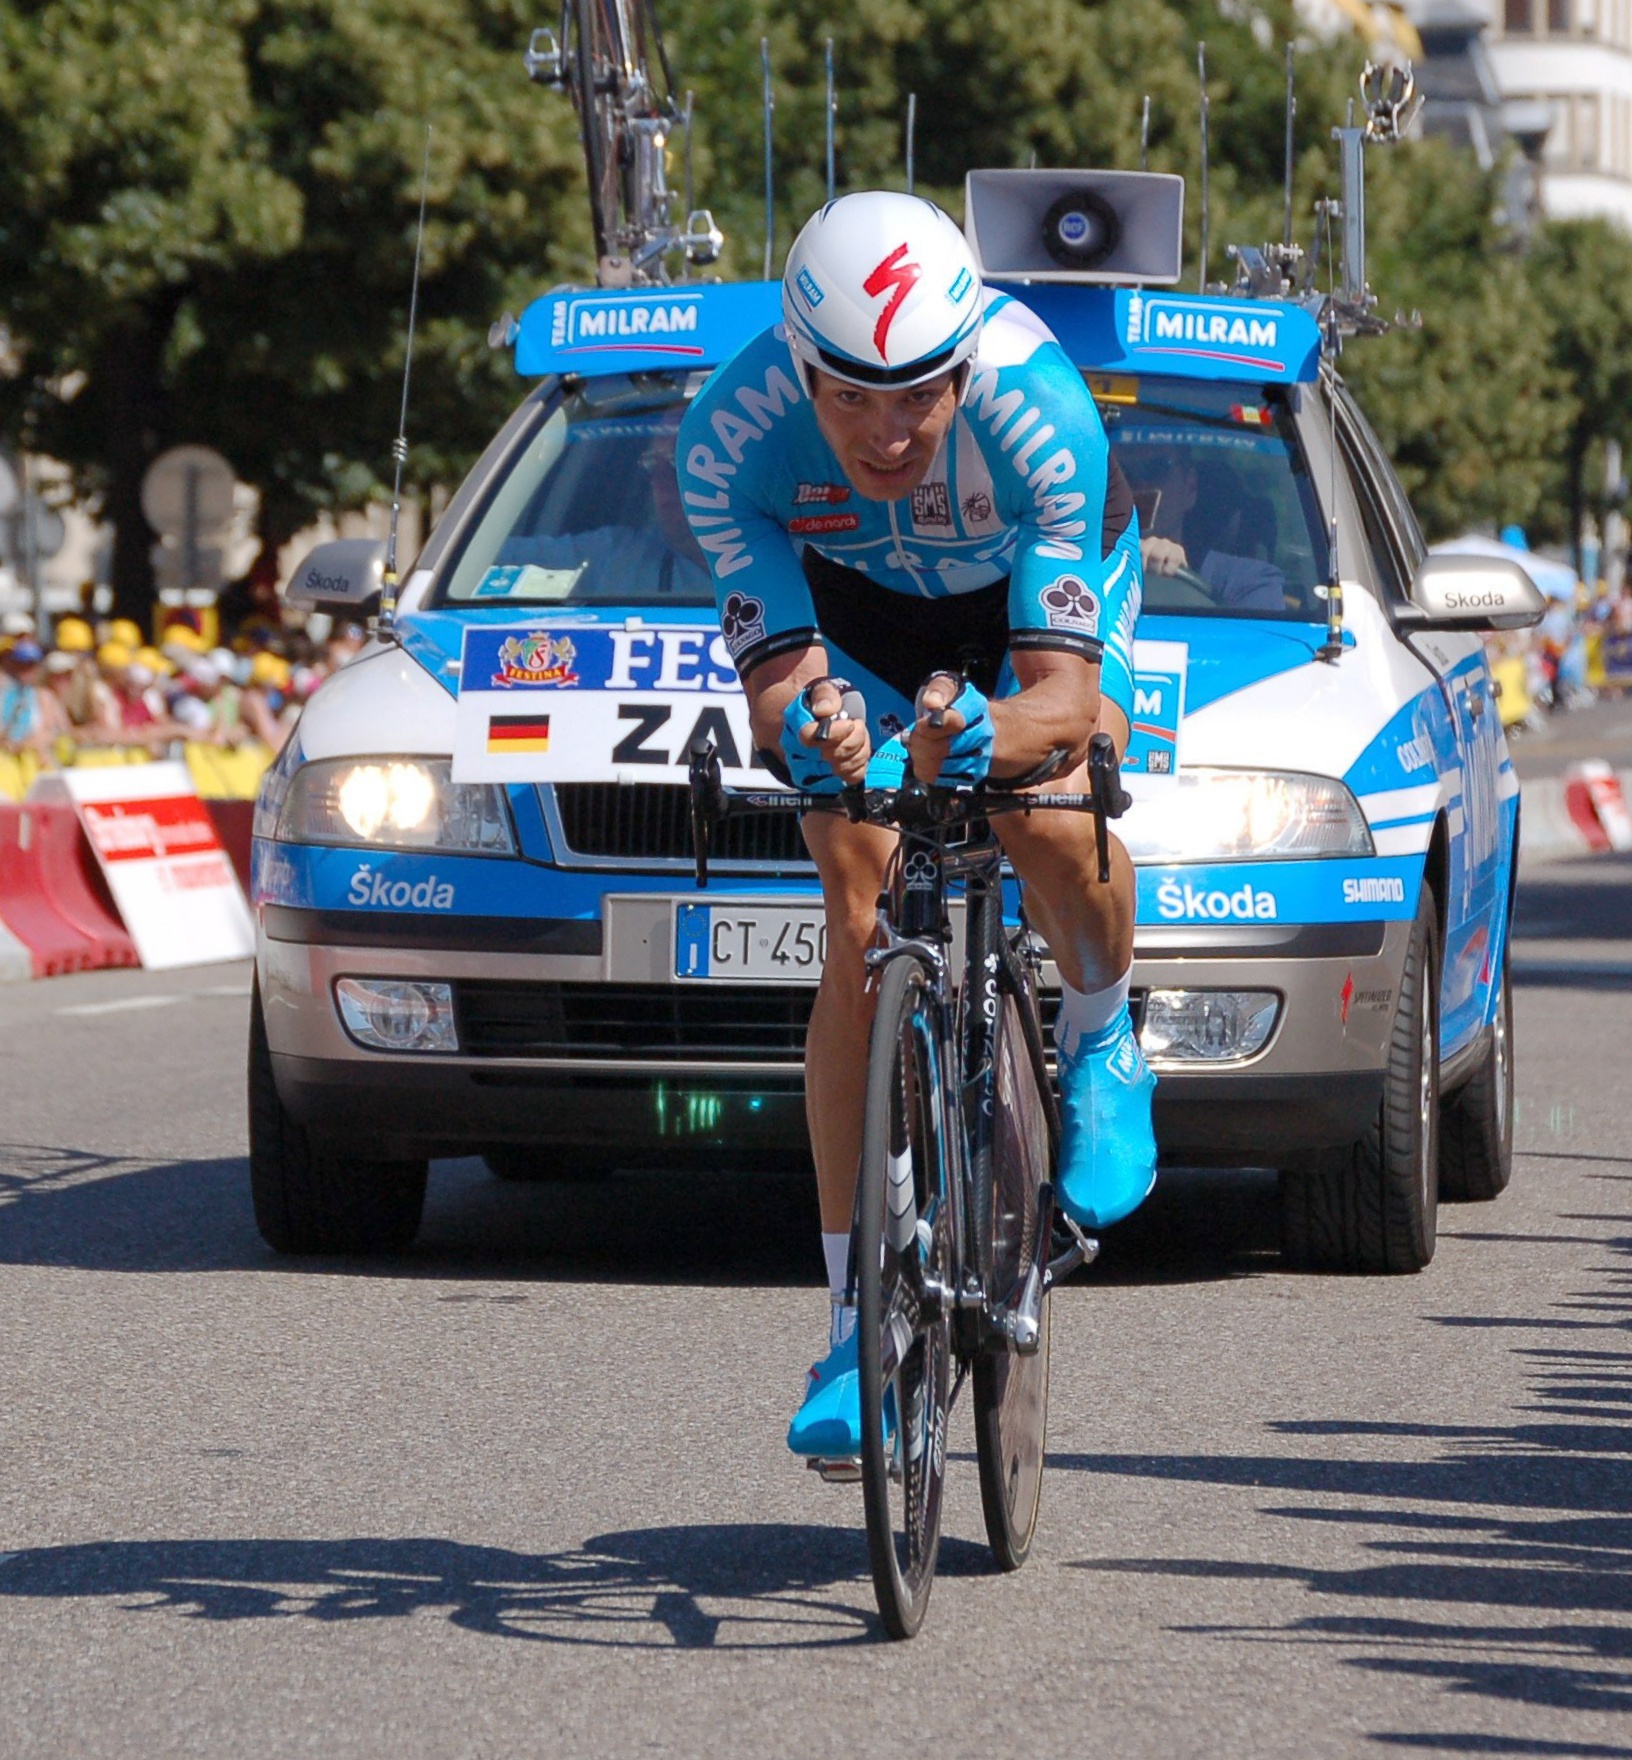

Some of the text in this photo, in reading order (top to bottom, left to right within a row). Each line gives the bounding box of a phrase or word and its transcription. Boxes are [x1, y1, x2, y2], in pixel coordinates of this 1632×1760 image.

[551, 300, 567, 347] TEAM
[579, 305, 697, 337] MILRAM
[1127, 294, 1144, 343] TEAM
[1155, 311, 1276, 347] MILRAM
[684, 365, 800, 578] MILRAM
[966, 368, 1087, 561] MILRAM
[305, 566, 350, 593] Škoda
[508, 666, 562, 680] FESTINA
[604, 631, 743, 690] FES
[611, 704, 768, 769] ZA
[347, 864, 454, 909] Škoda
[1157, 878, 1277, 919] Škoda
[1343, 877, 1404, 903] SHIMANO
[713, 920, 757, 965] CT
